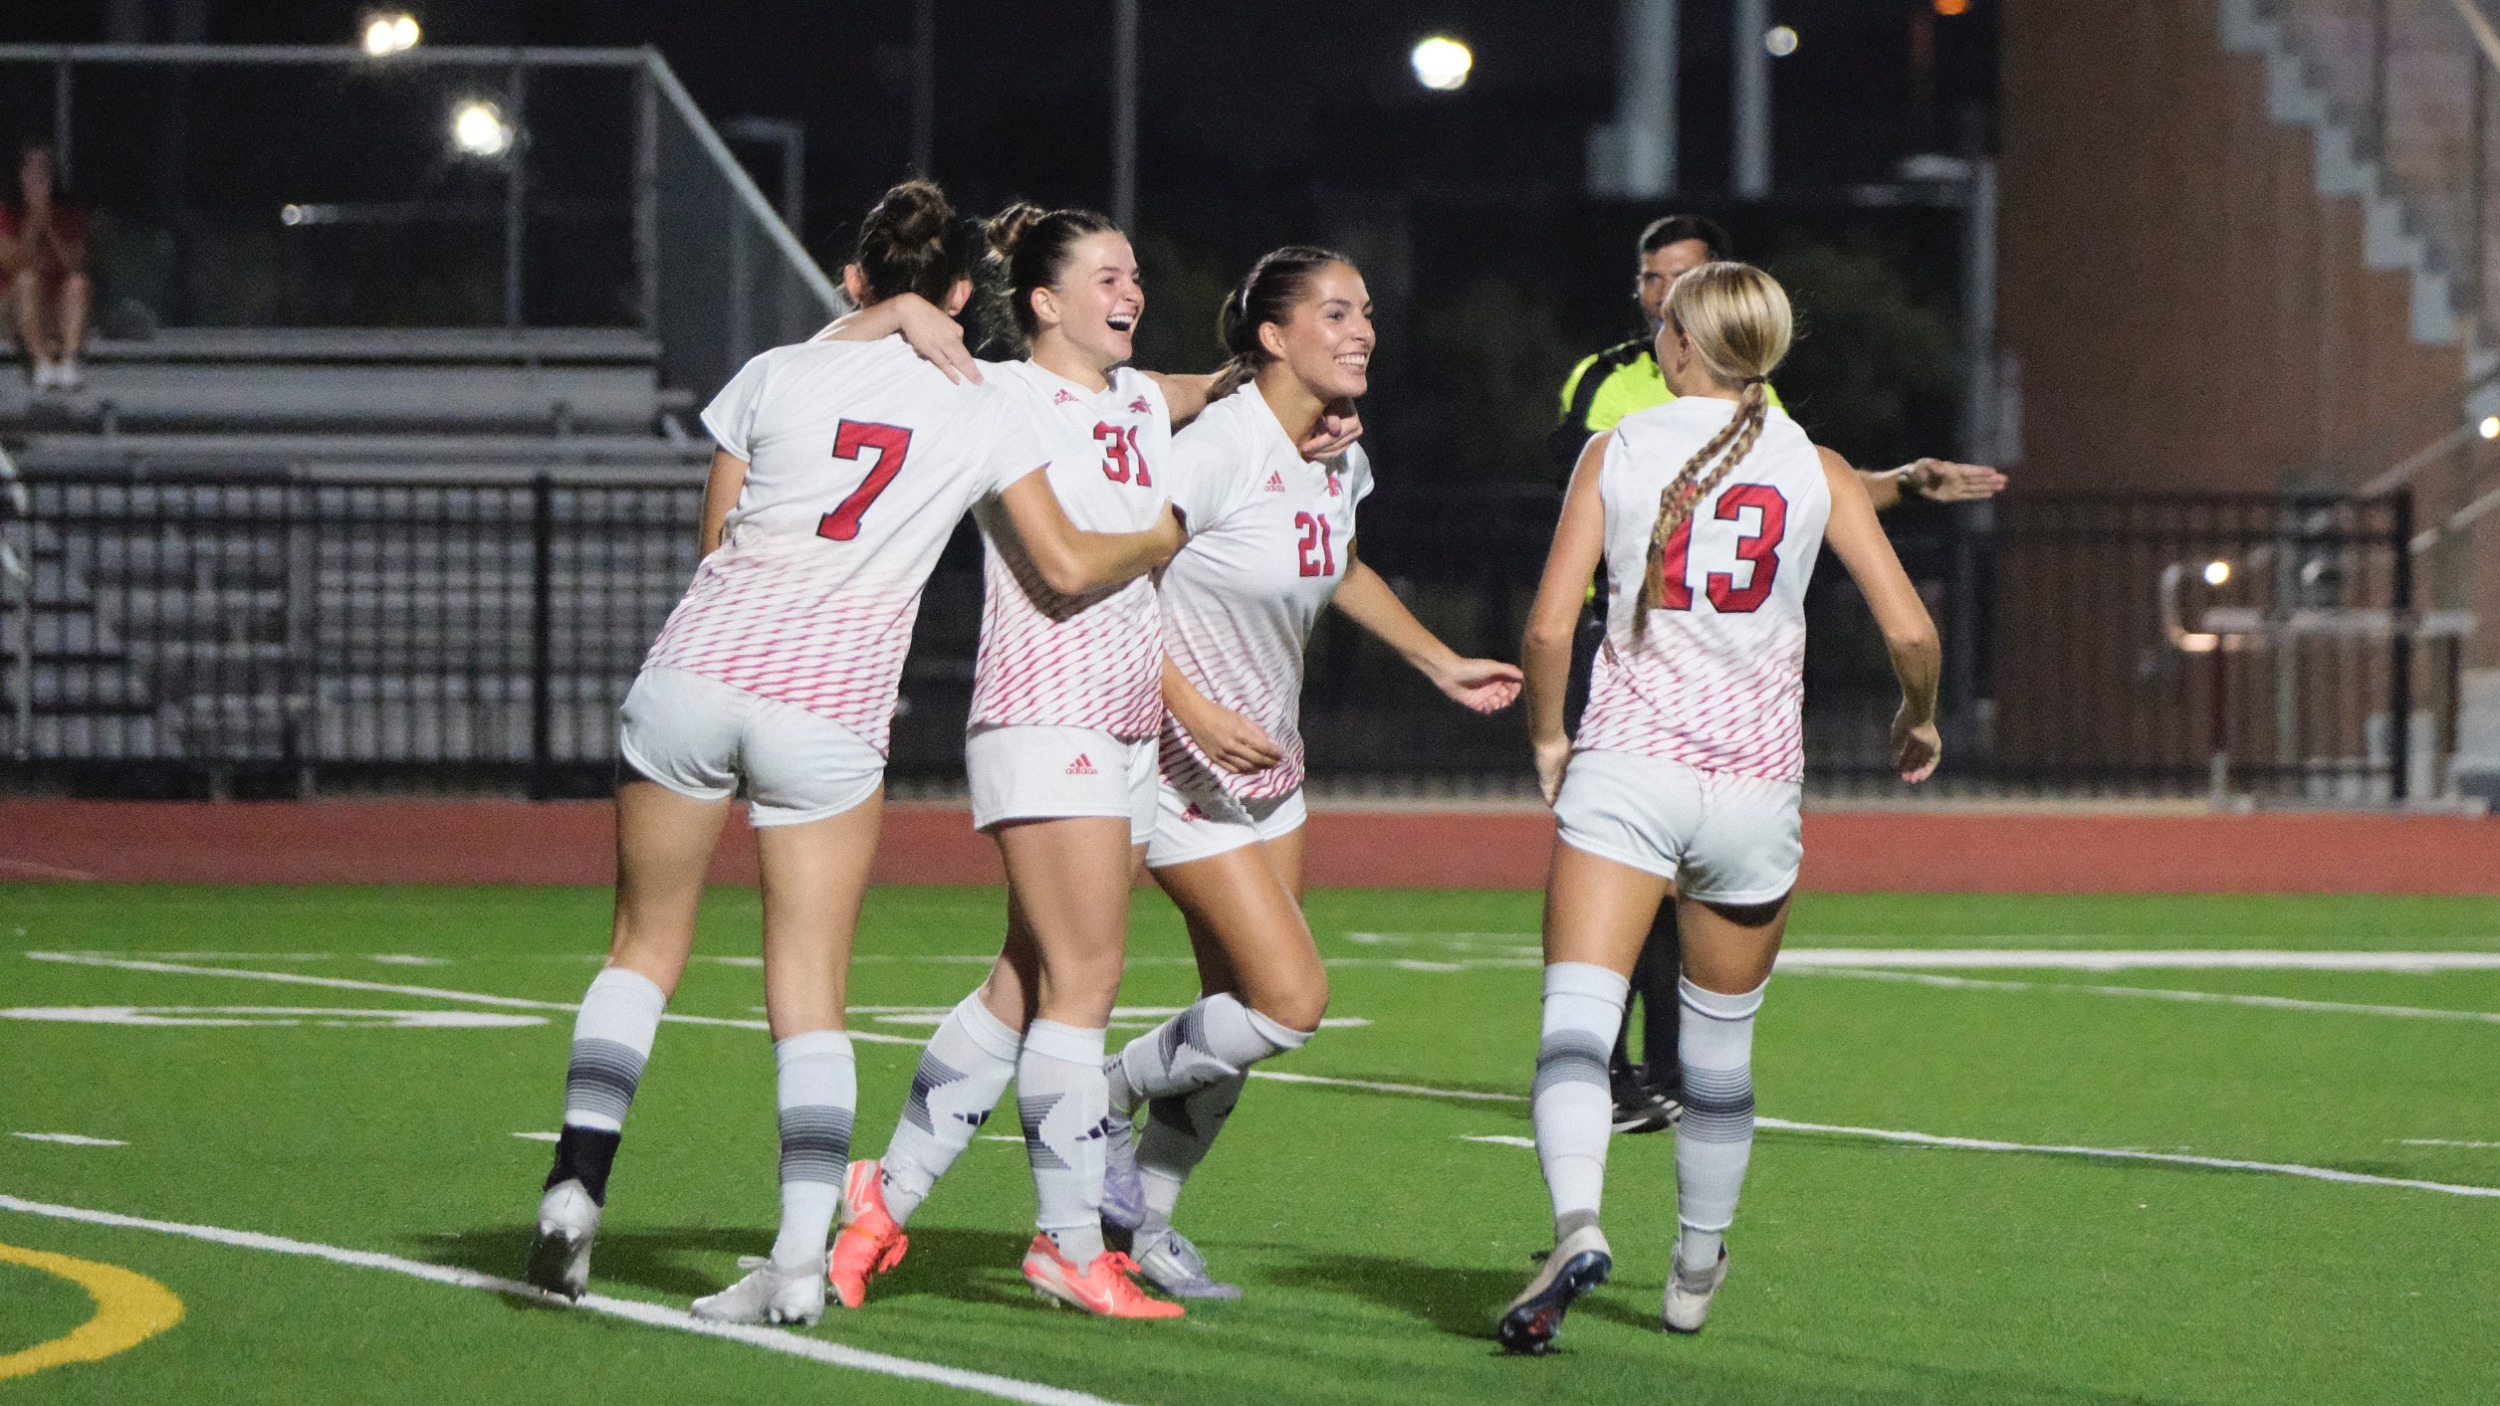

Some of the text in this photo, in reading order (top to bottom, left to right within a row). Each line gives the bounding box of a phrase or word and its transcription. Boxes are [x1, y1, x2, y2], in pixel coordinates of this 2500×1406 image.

[816, 417, 913, 541] 7
[1093, 420, 1152, 487] 31
[1294, 510, 1335, 577] 21
